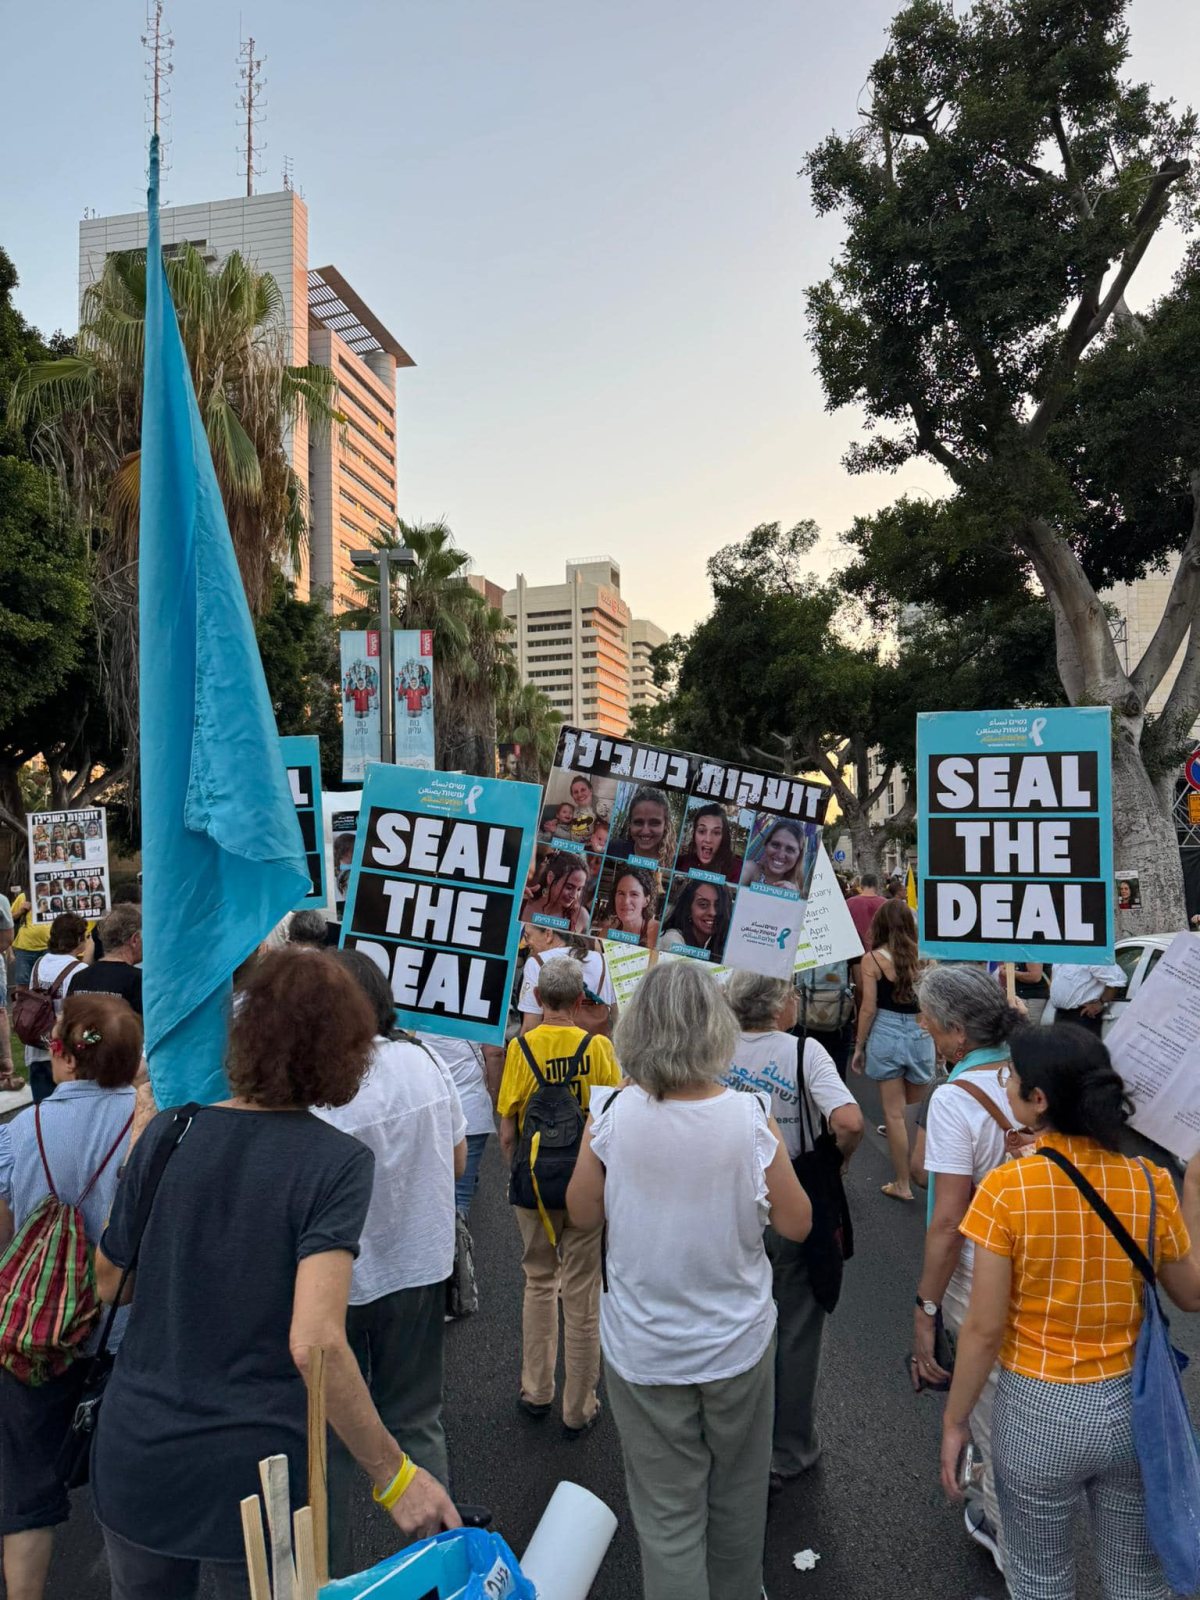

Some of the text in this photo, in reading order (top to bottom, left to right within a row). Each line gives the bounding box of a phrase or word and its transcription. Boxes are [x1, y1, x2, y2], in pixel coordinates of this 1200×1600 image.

[560, 731, 823, 819] זועקות בשבילן
[936, 755, 1091, 809] SEAL
[371, 812, 512, 883] SEAL
[955, 821, 1071, 874] THE
[382, 880, 488, 947] THE
[803, 906, 829, 919] March
[809, 923, 830, 936] April
[936, 882, 1094, 941] DEAL
[815, 943, 832, 954] May
[775, 1115, 800, 1124] eace
